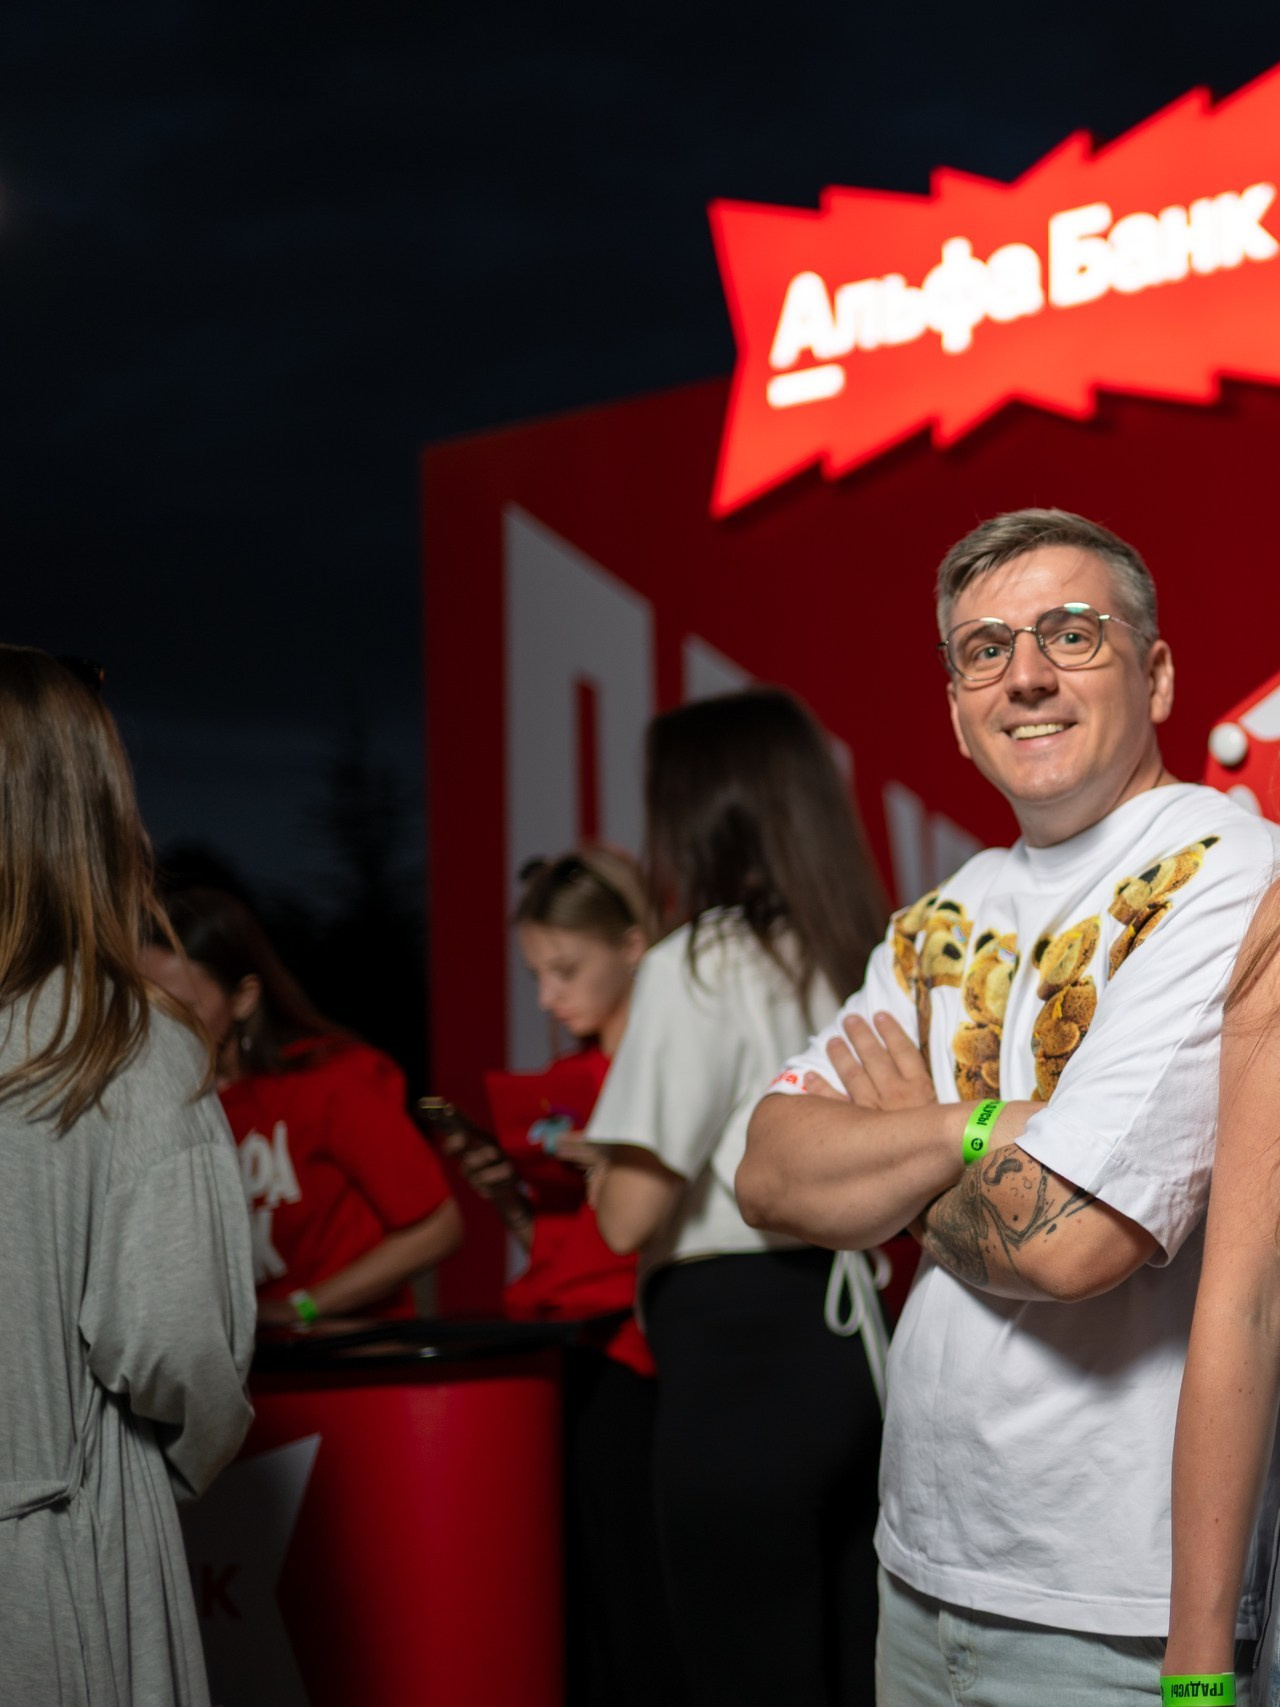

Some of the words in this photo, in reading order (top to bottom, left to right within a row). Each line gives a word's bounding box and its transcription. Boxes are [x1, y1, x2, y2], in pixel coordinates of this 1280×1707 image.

[769, 236, 1044, 372] Альфа
[1048, 182, 1280, 309] Банк
[1171, 1681, 1224, 1698] ГРАДУСЫ
